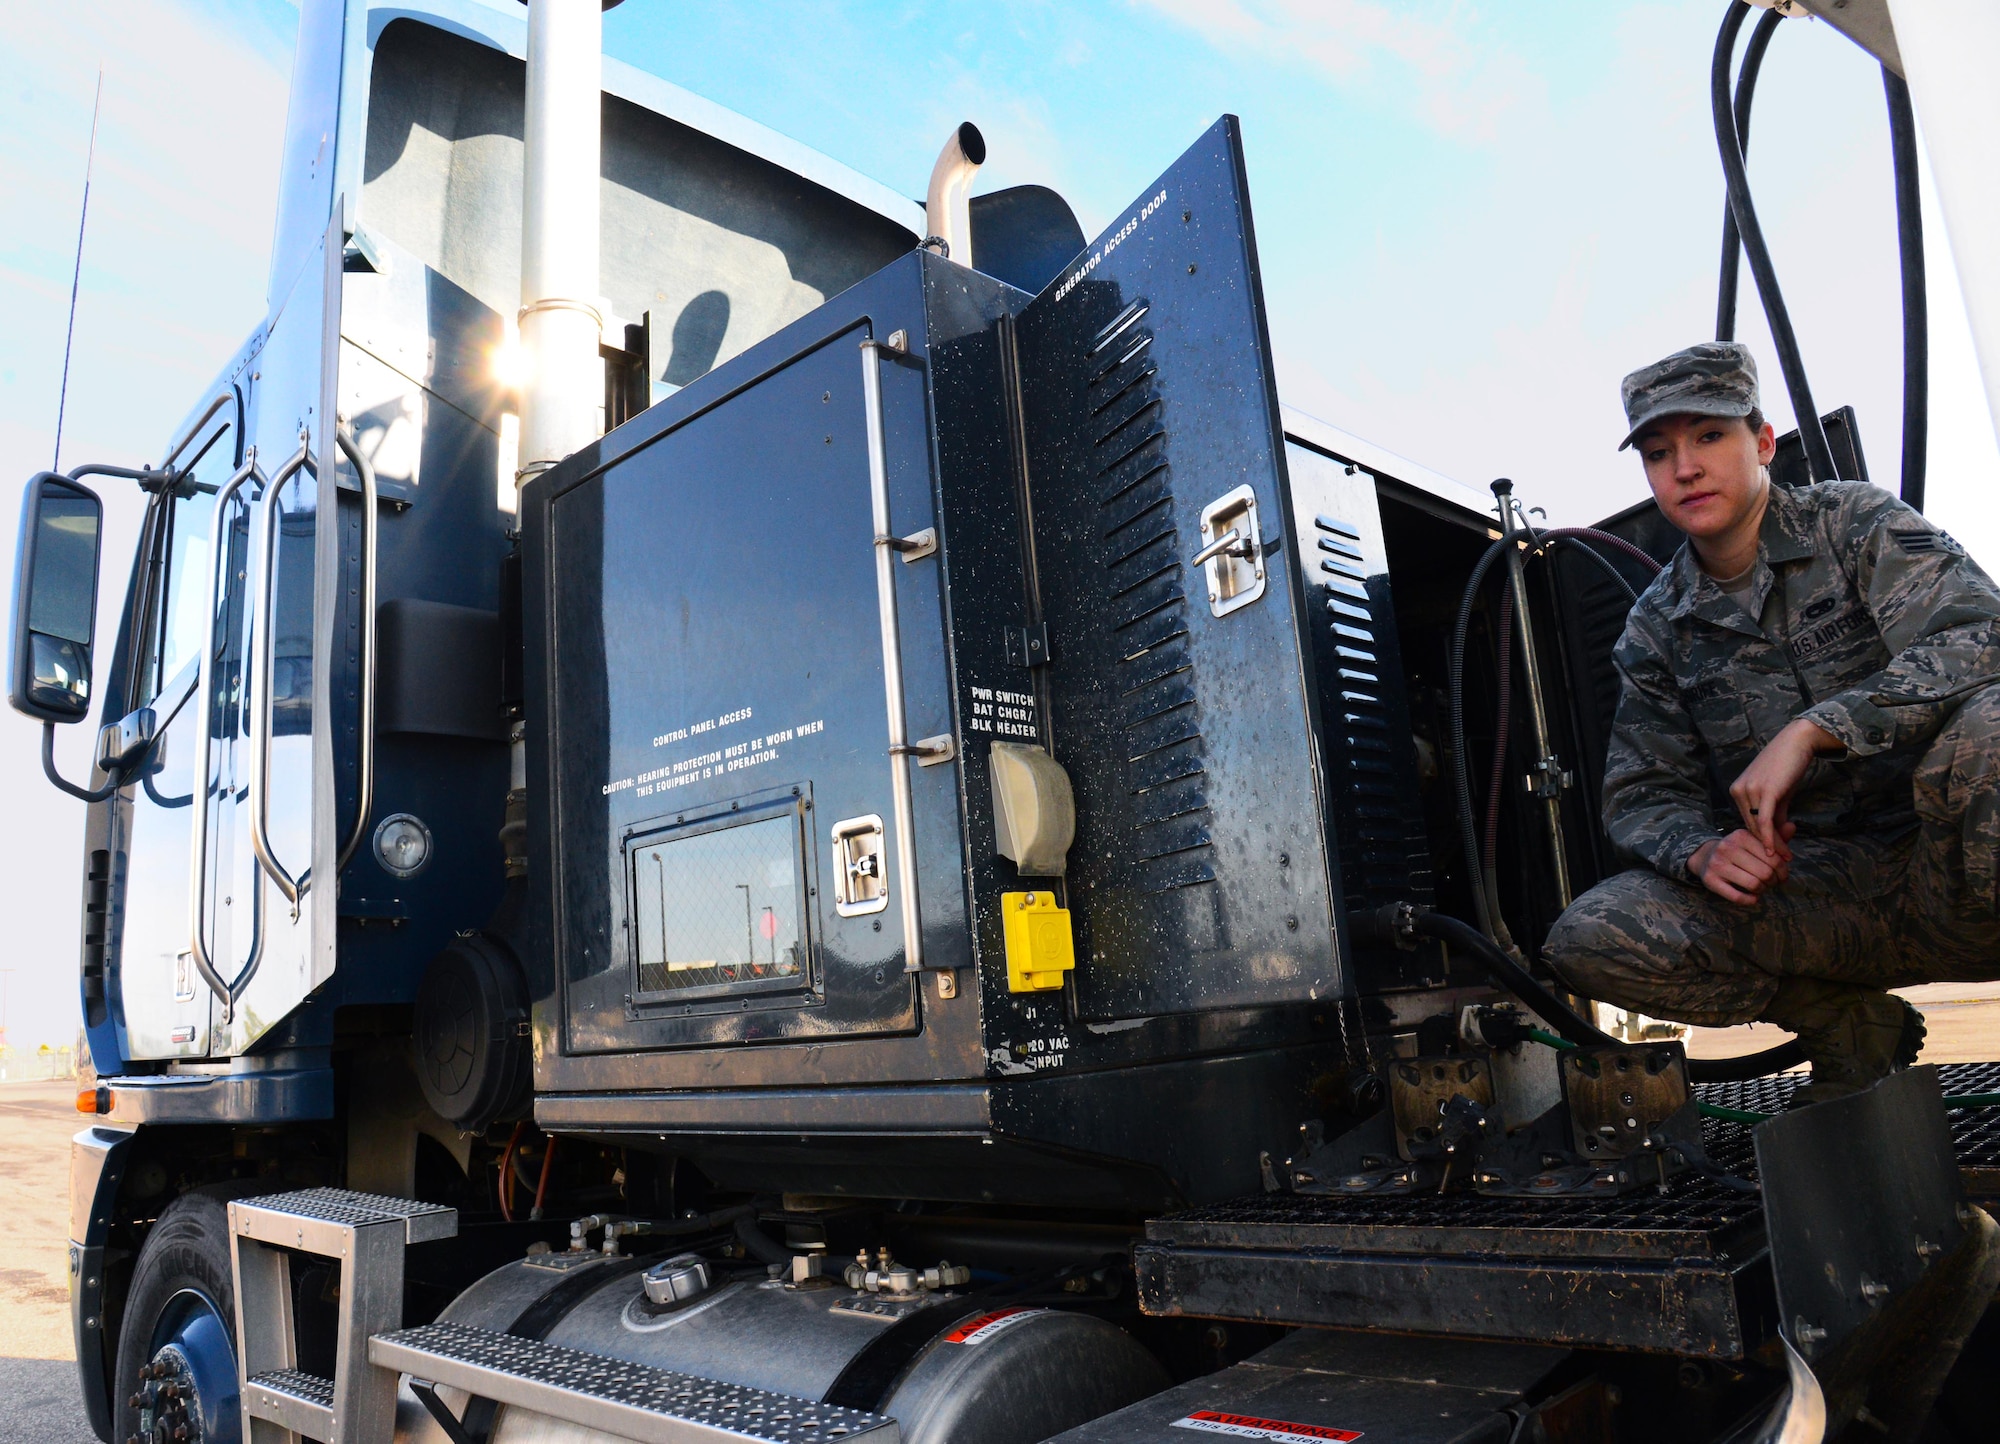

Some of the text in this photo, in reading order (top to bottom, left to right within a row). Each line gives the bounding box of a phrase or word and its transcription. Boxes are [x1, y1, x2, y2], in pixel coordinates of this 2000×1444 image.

[1055, 189, 1167, 302] GENERATOR ACCESS DOOR
[1814, 624, 1839, 647] AIR
[971, 686, 1034, 707] PWR SWITCH
[973, 702, 1033, 722] BAT CHGR/
[653, 707, 752, 748] CONTROL PANEL ACCESS
[971, 718, 1036, 737] BLK HEATER
[602, 719, 824, 796] CAUTION: HEARING PROTECTION MUST BE WORN WHEN
[637, 748, 779, 798] THIS EQUIPMENT IS IN OPERATION.
[1026, 1007, 1037, 1020] J1
[1049, 1037, 1069, 1051] VAC
[1034, 1054, 1064, 1069] INPUT
[1189, 1420, 1221, 1431] This
[1223, 1425, 1239, 1433] is
[1242, 1429, 1271, 1438] not
[1286, 1435, 1324, 1444] step
[1225, 1414, 1344, 1440] WARNING
